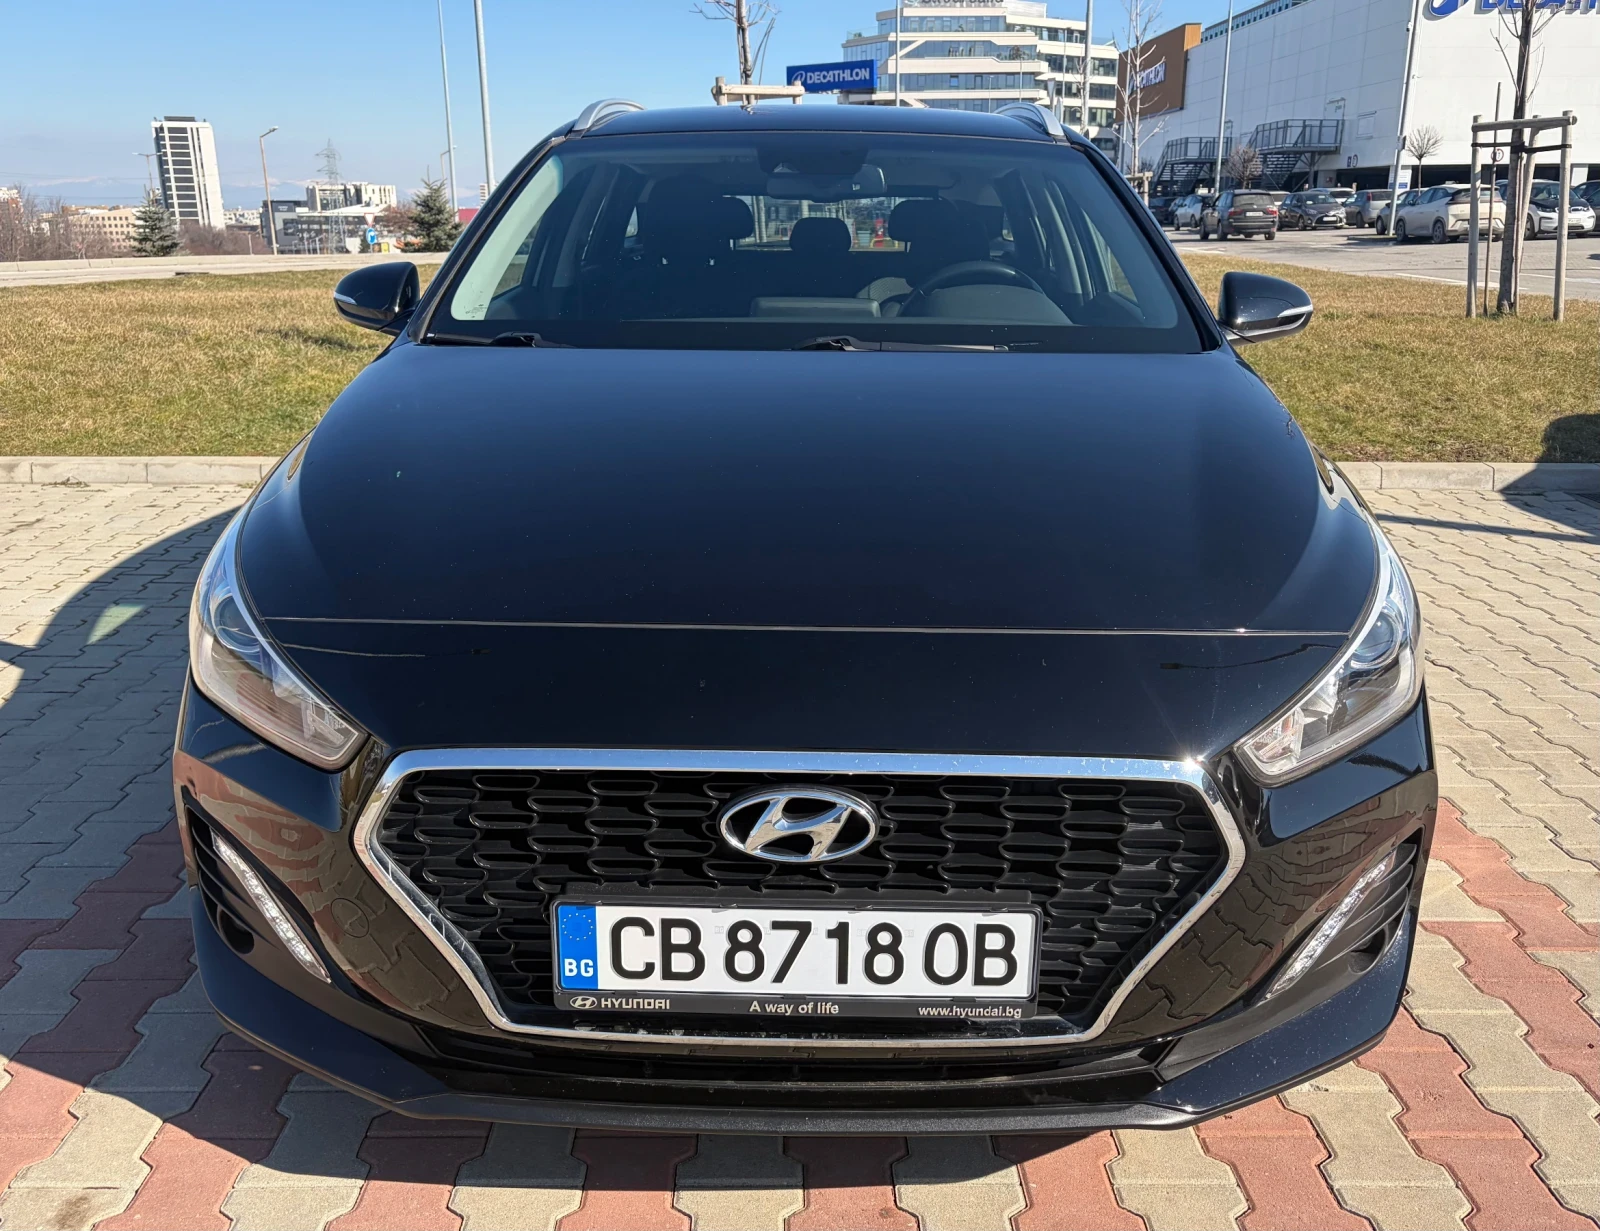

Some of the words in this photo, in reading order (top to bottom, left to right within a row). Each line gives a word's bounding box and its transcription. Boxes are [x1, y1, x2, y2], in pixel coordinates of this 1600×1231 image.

[807, 68, 870, 84] DECATHLON
[611, 917, 706, 981] CB
[724, 920, 904, 985] 8718
[564, 958, 594, 977] BG
[601, 998, 670, 1009] HYUNDAI
[750, 1001, 761, 1012] A
[765, 1004, 793, 1015] way
[798, 1002, 814, 1013] of
[817, 1002, 839, 1013] life
[918, 1005, 1022, 1018] www.hyundai.bg
